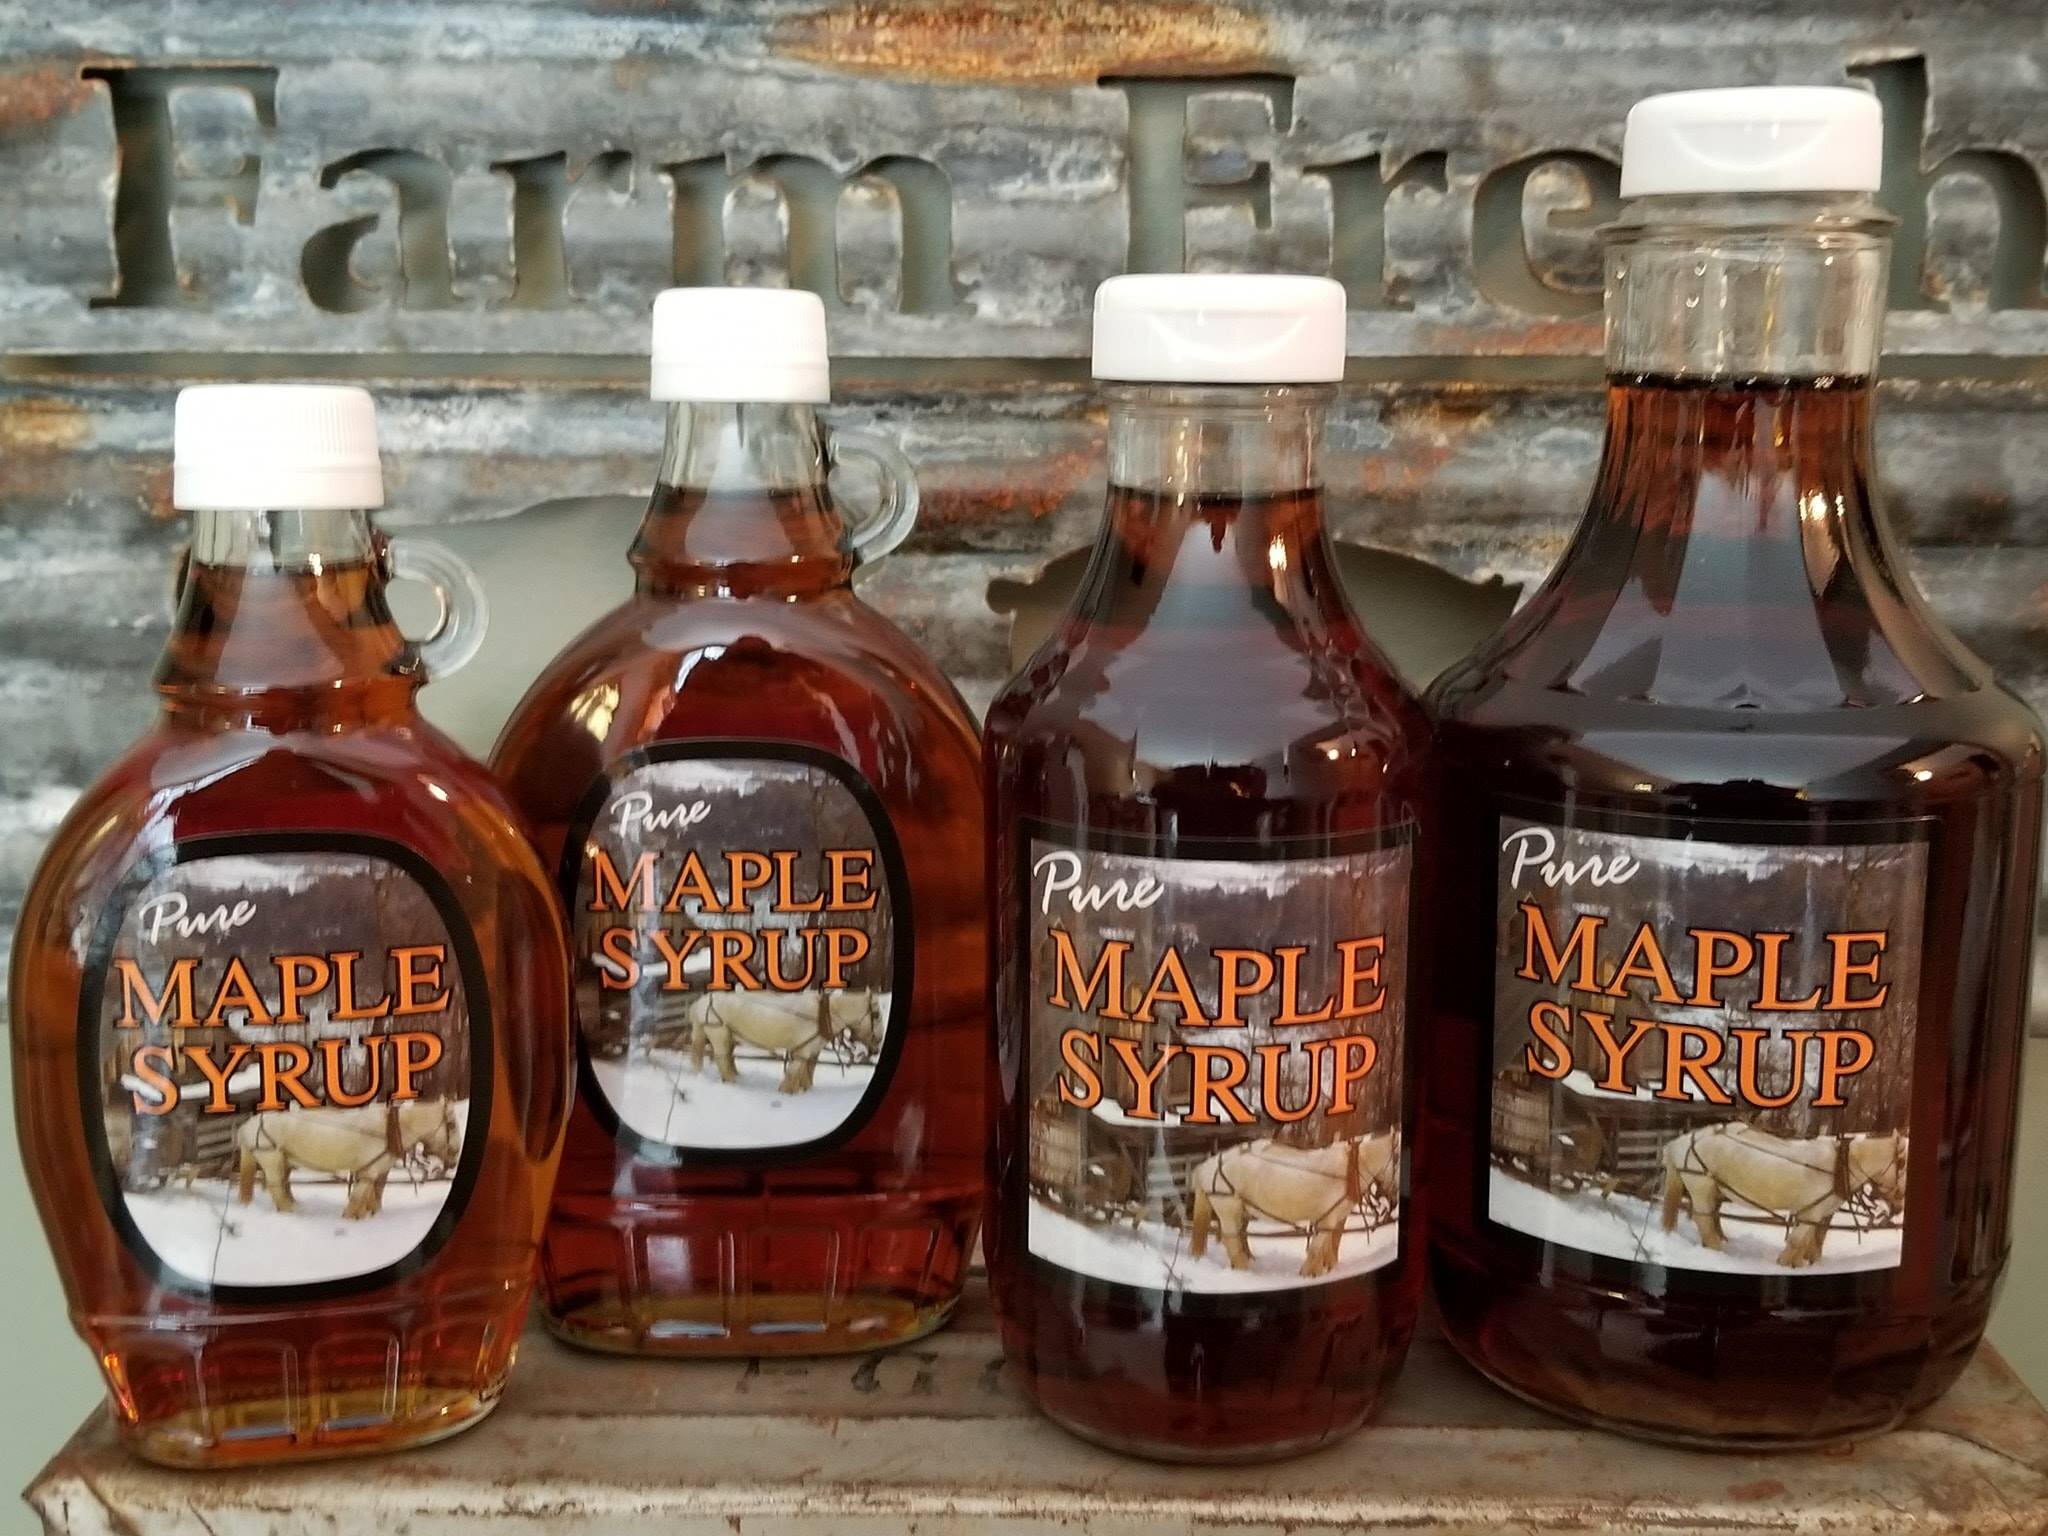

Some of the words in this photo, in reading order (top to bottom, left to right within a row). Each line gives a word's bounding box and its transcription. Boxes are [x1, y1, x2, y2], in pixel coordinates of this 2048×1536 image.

[80, 66, 976, 313] Farm
[1097, 52, 2048, 313] Freh
[611, 791, 712, 839] Pure
[587, 848, 880, 914] MAPLE
[1033, 850, 1165, 915] Pure
[1502, 826, 1640, 890] Pure
[139, 891, 257, 946] Pure
[600, 927, 872, 991] SYRUP
[1515, 900, 1890, 1012] MAPLE
[113, 944, 451, 1030] MAPLE
[1048, 928, 1388, 1028] MAPLE
[132, 1031, 444, 1115] SYRUP
[1058, 1027, 1378, 1125] SYRUP
[1526, 1000, 1876, 1108] SYRUP
